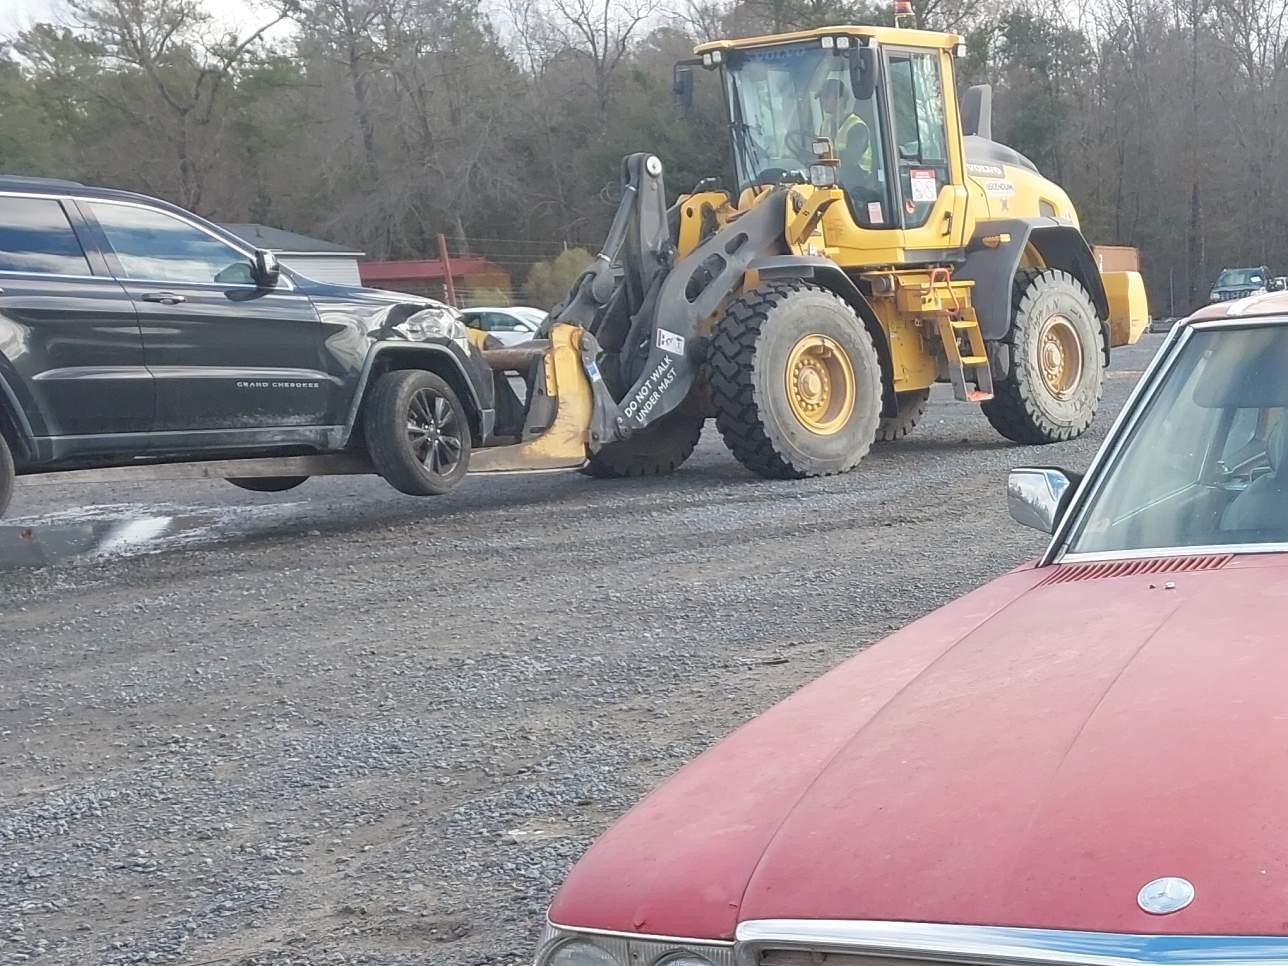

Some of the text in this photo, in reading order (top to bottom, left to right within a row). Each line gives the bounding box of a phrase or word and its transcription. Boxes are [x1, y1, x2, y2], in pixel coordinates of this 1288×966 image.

[624, 354, 673, 418] DO NOT WALK
[635, 367, 677, 423] UNDER MAST
